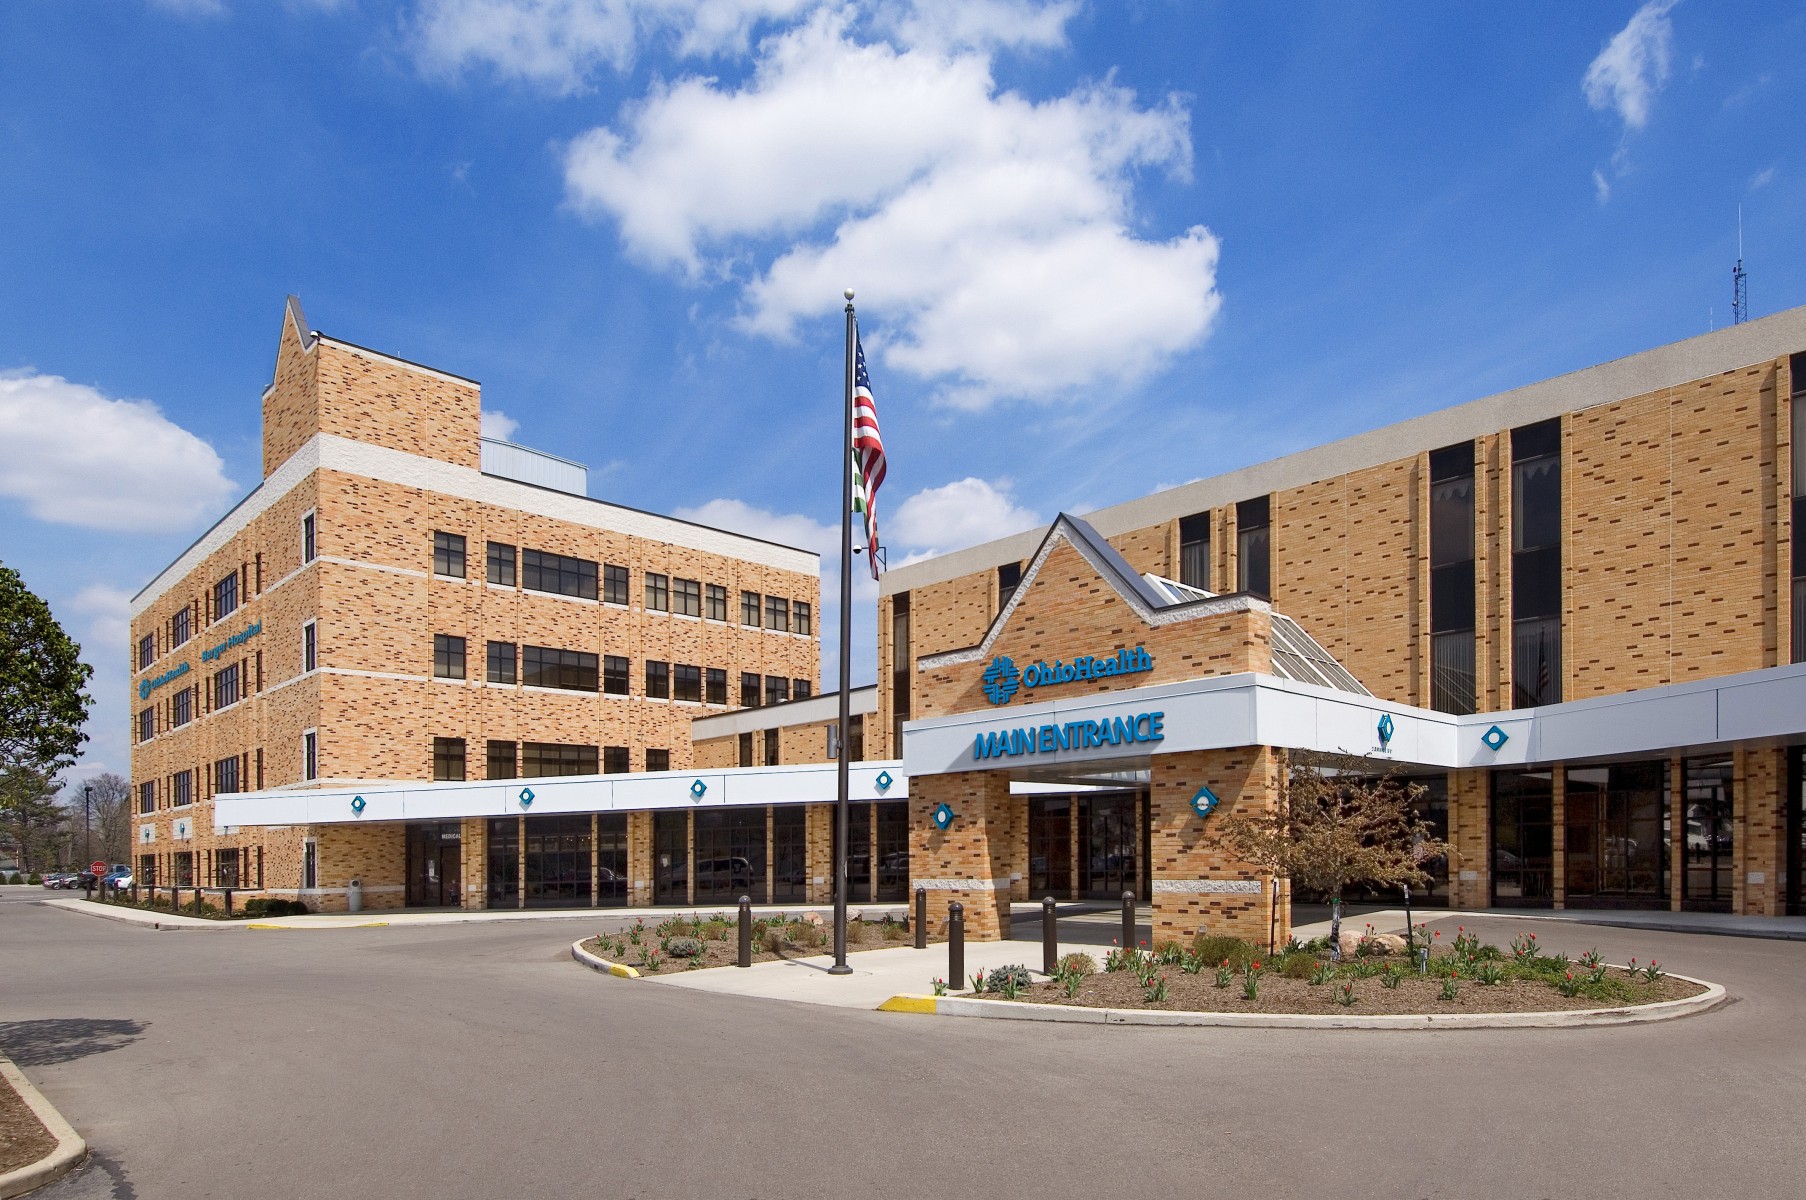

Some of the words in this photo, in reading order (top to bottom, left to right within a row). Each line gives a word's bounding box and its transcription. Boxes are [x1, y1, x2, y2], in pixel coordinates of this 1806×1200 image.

[201, 641, 227, 662] Berger
[227, 618, 262, 649] Hospital
[1023, 646, 1154, 688] OhioHealth
[975, 727, 1036, 759] MAIN
[1039, 711, 1164, 751] ENTRANCE
